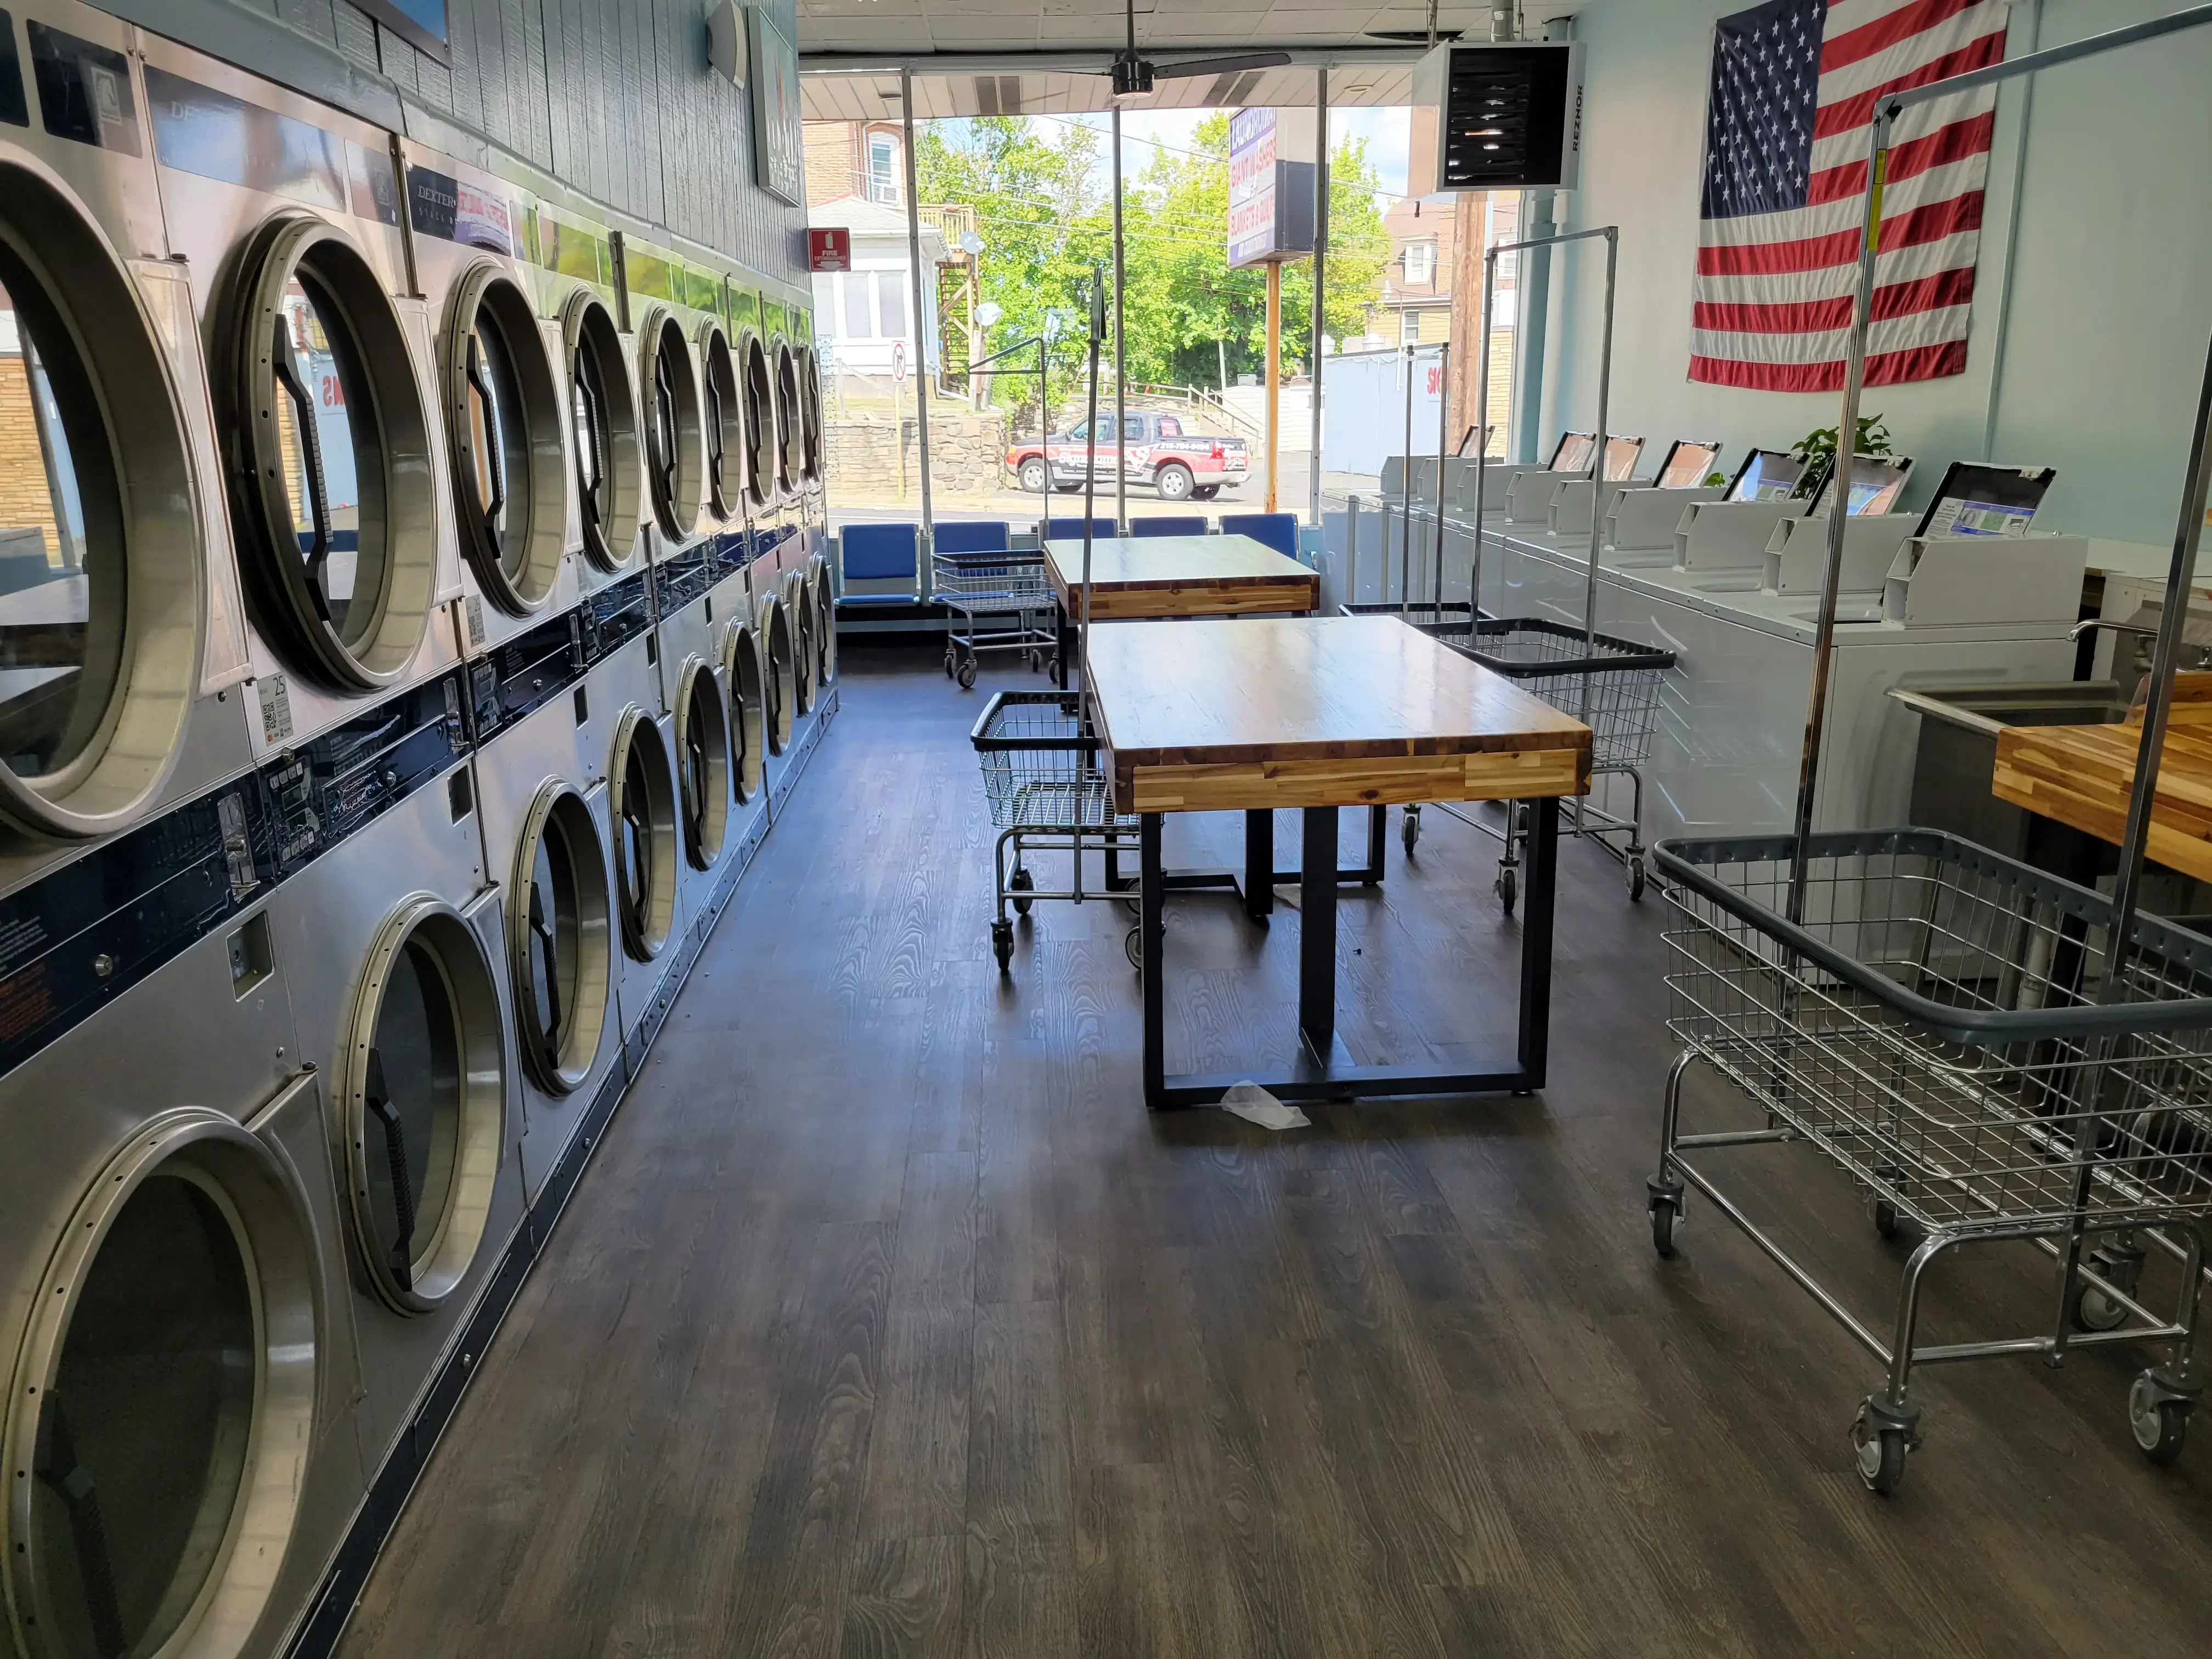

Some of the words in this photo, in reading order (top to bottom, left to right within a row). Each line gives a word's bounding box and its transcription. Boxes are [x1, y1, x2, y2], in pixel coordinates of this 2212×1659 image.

[1572, 84, 1583, 152] REZNOR
[418, 185, 455, 208] DEXTER
[273, 675, 285, 697] 25
